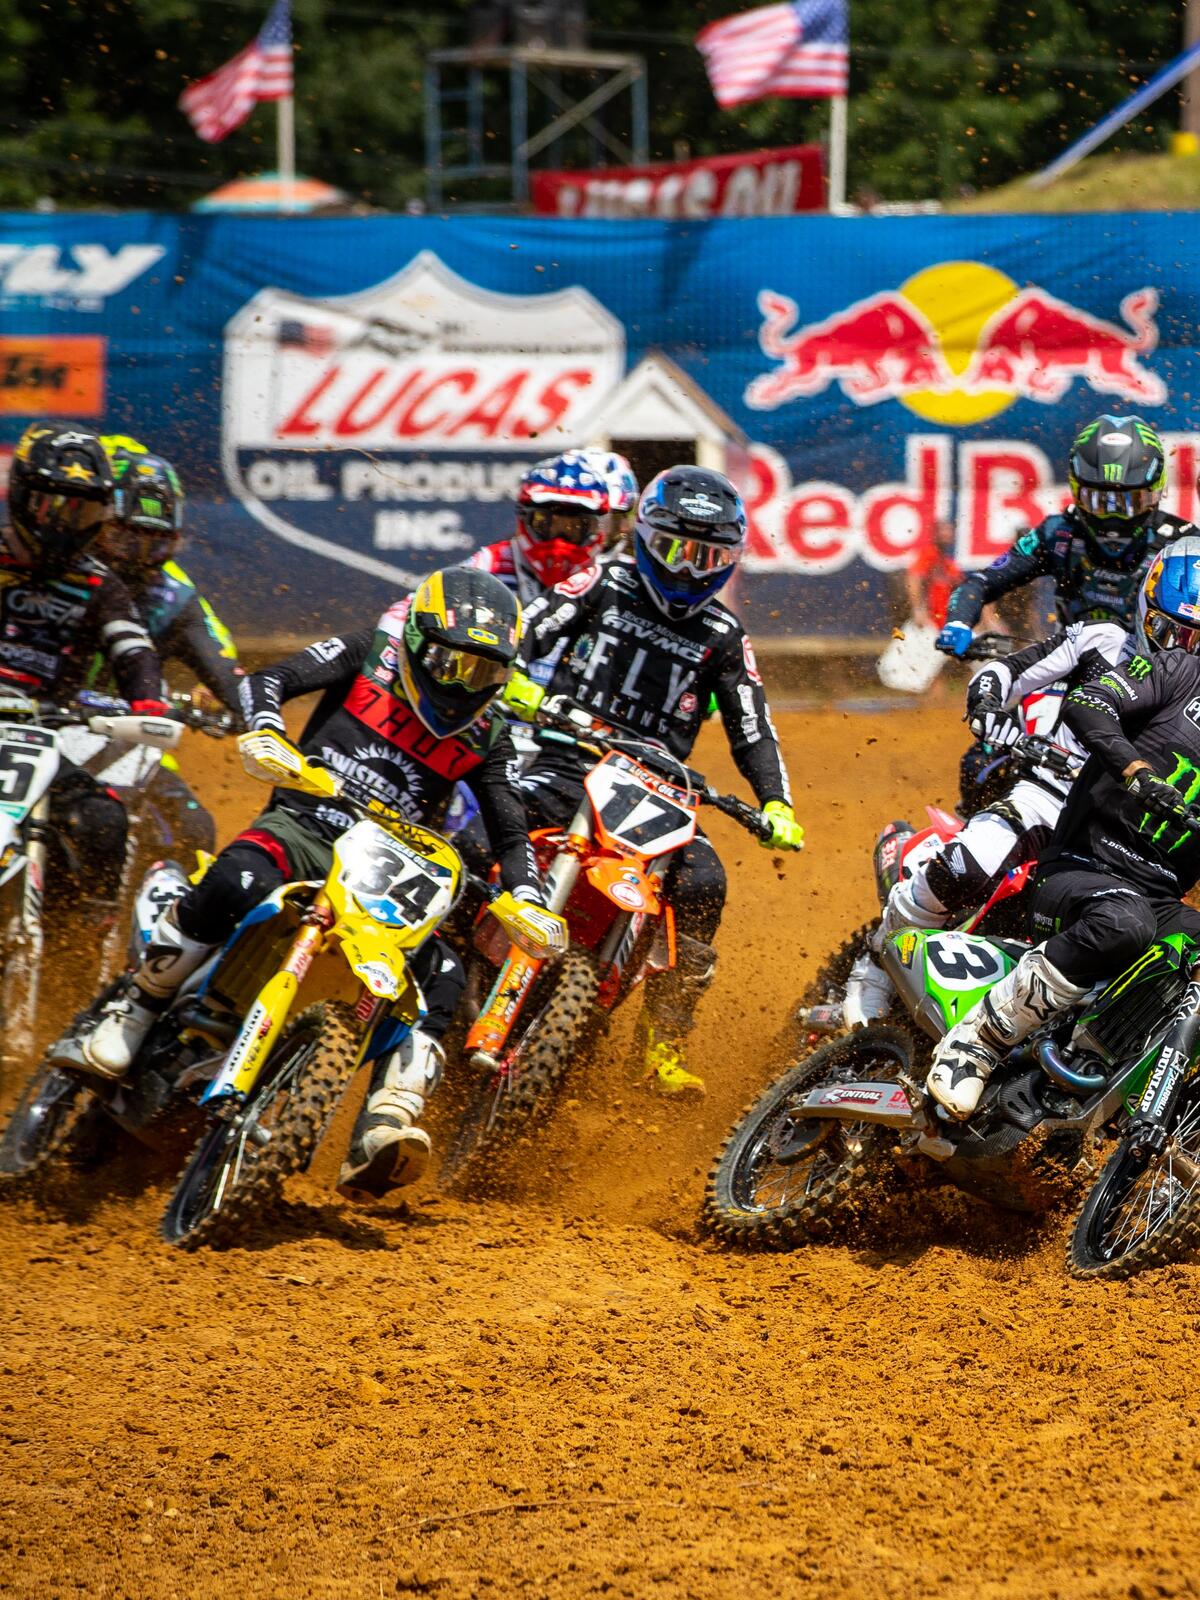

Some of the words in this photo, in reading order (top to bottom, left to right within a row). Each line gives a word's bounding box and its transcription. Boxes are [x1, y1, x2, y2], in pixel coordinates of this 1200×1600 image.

[275, 366, 596, 438] LUCAS
[247, 459, 334, 499] OIL
[373, 509, 474, 550] INC.
[583, 631, 696, 715] FLY
[576, 684, 668, 734] RACING
[600, 781, 692, 848] 17
[351, 844, 441, 926] 34
[926, 940, 999, 980] 3
[1140, 1046, 1174, 1113] DUNLOP
[1155, 1079, 1177, 1117] CARRILLO
